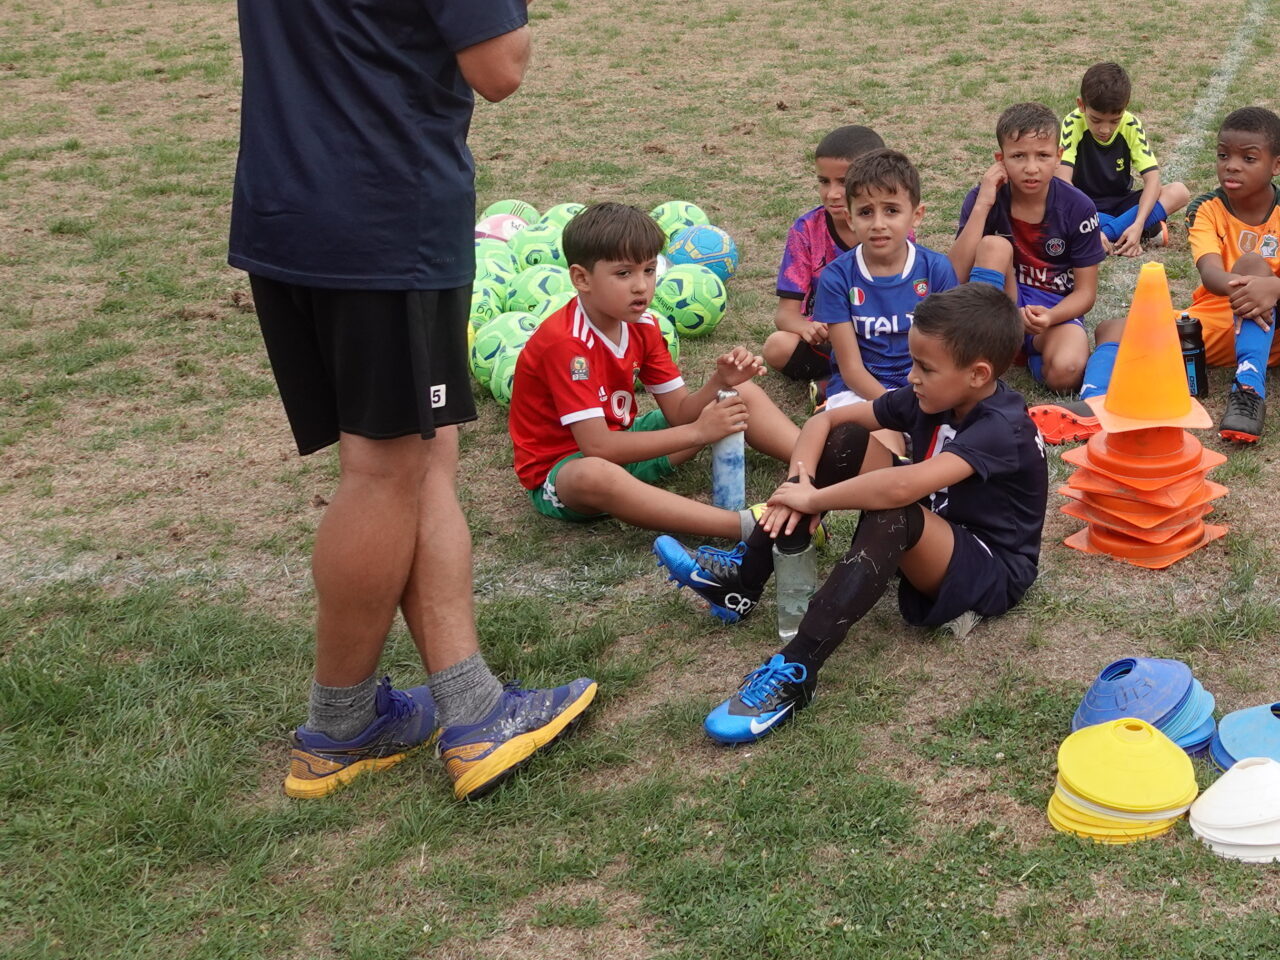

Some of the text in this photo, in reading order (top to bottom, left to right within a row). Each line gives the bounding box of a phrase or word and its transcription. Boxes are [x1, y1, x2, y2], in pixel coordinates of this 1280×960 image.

[1079, 212, 1100, 234] QN
[433, 389, 441, 404] 5
[611, 390, 633, 427] 9
